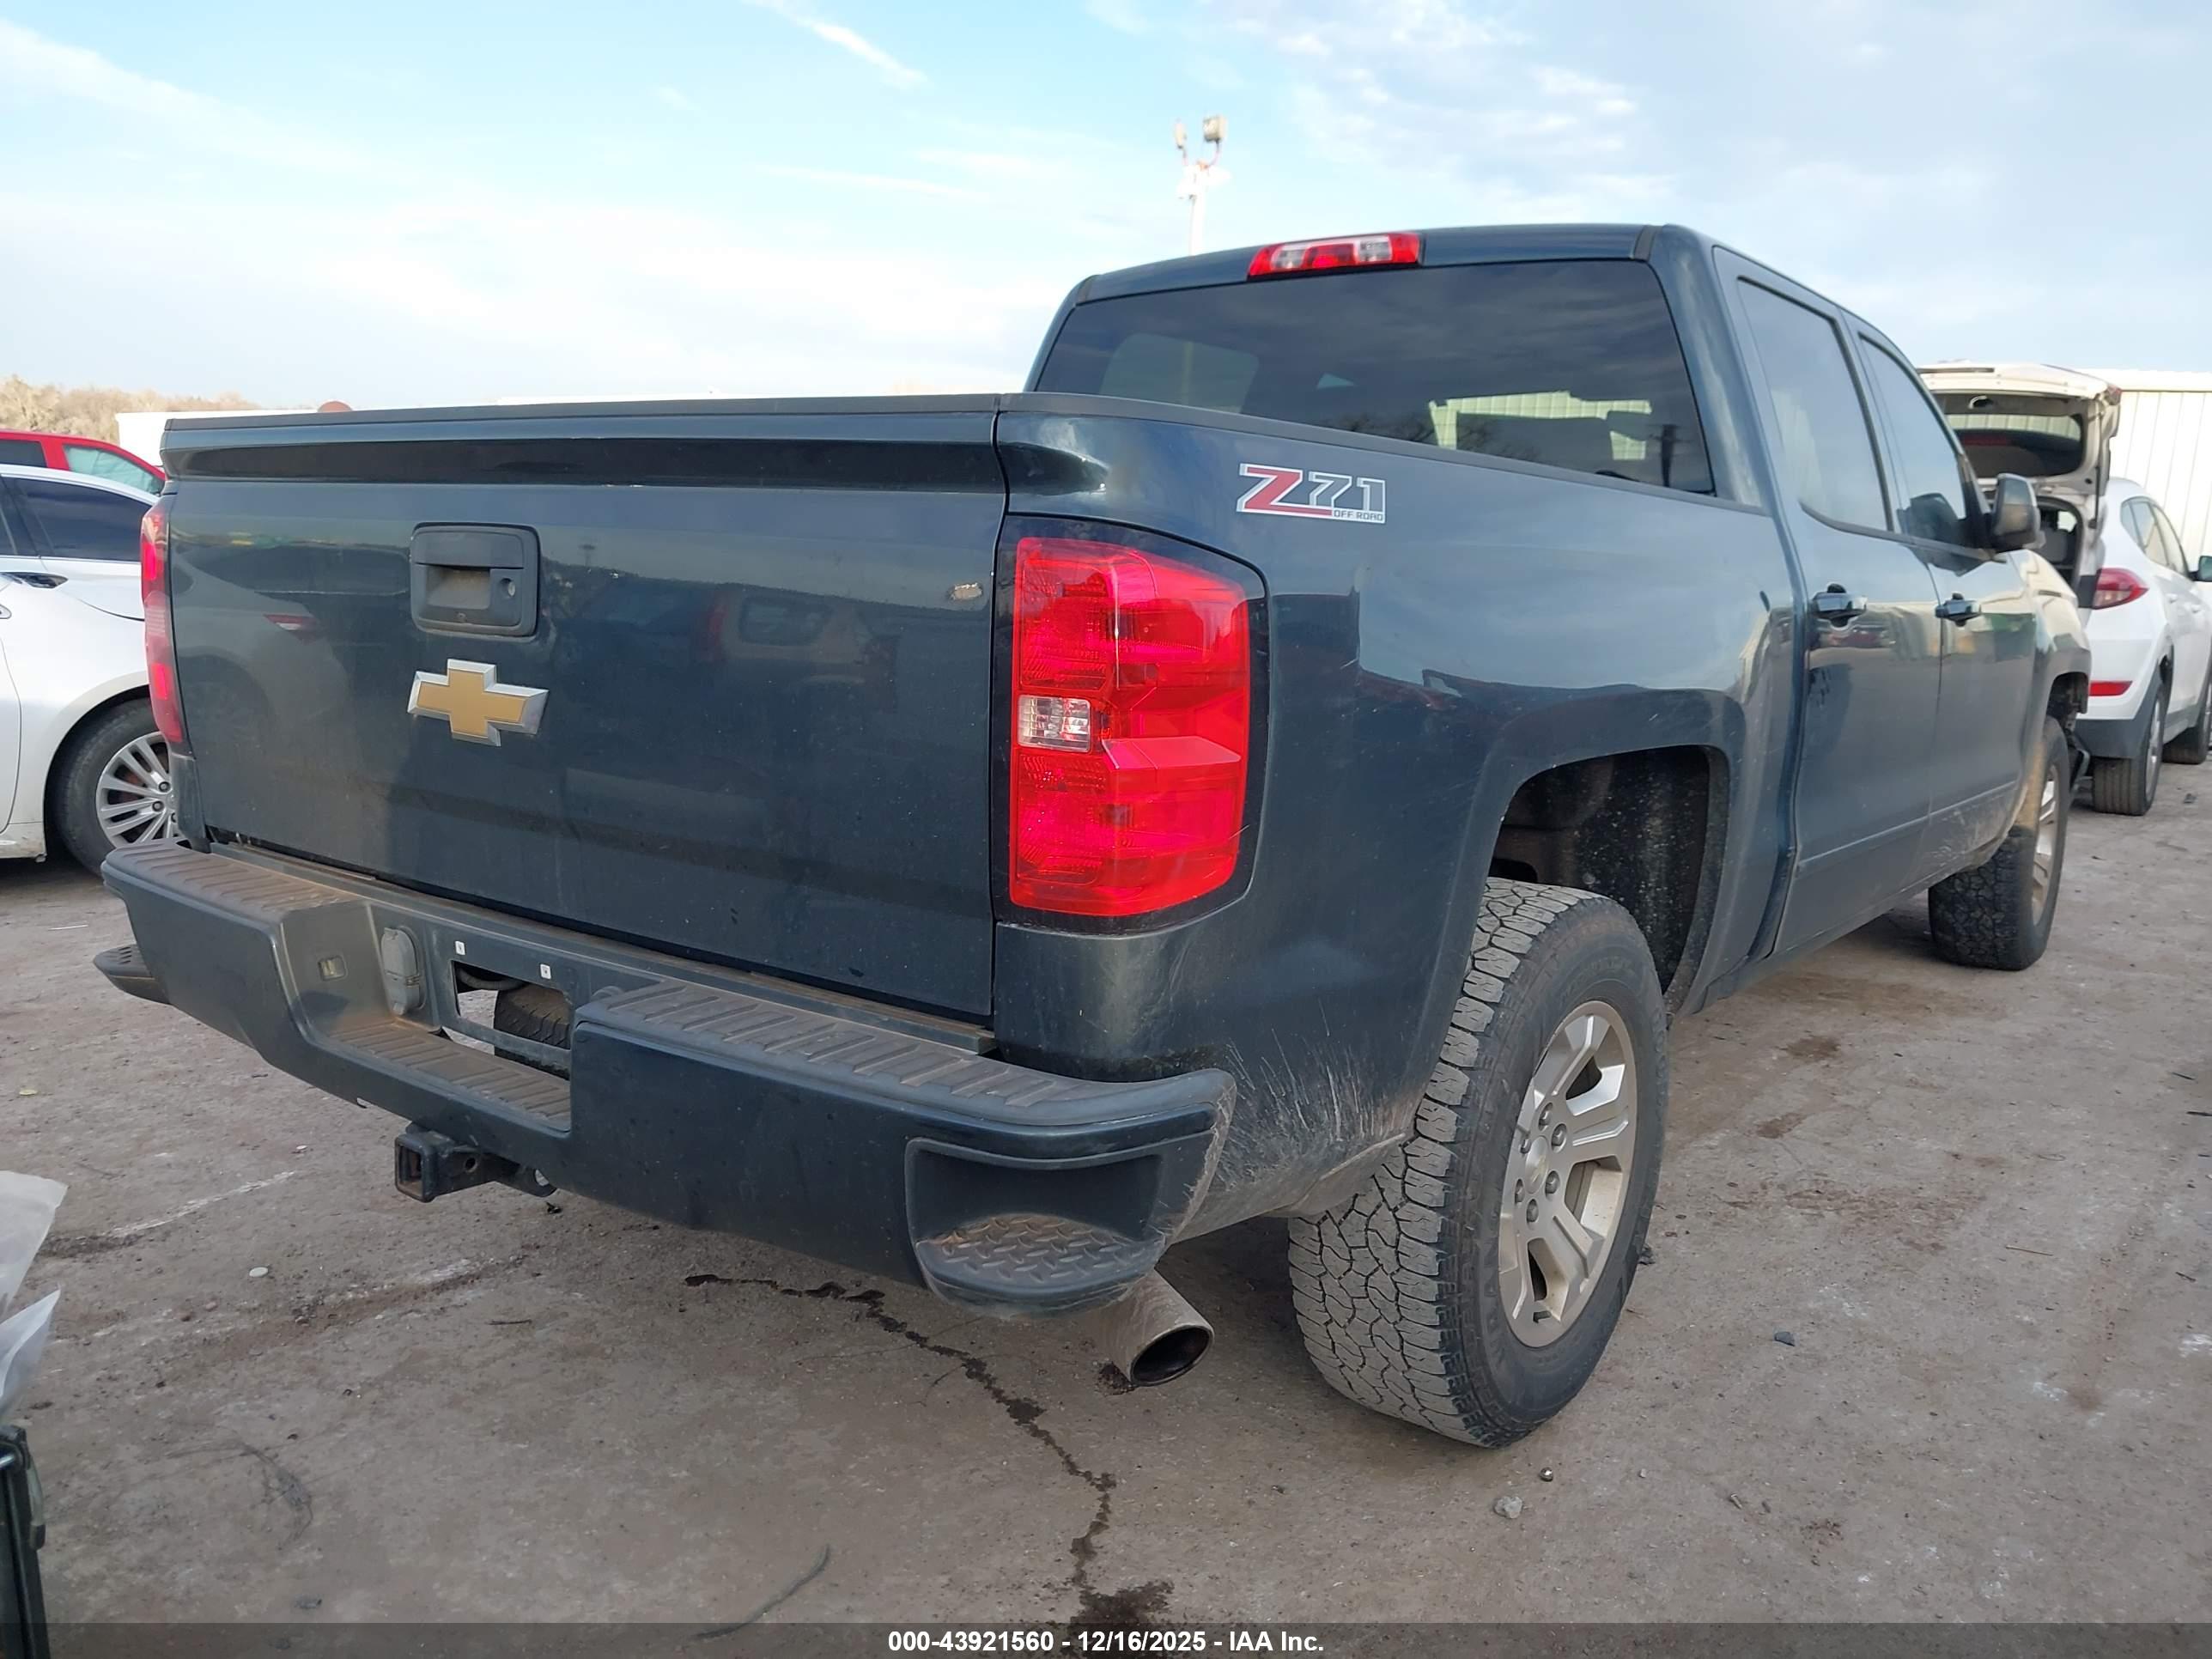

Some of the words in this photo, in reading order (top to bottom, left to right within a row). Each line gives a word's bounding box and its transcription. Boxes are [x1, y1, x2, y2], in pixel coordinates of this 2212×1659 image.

[1237, 463, 1386, 514] Z71
[1333, 509, 1354, 520] OFF
[1356, 511, 1384, 522] ROAD
